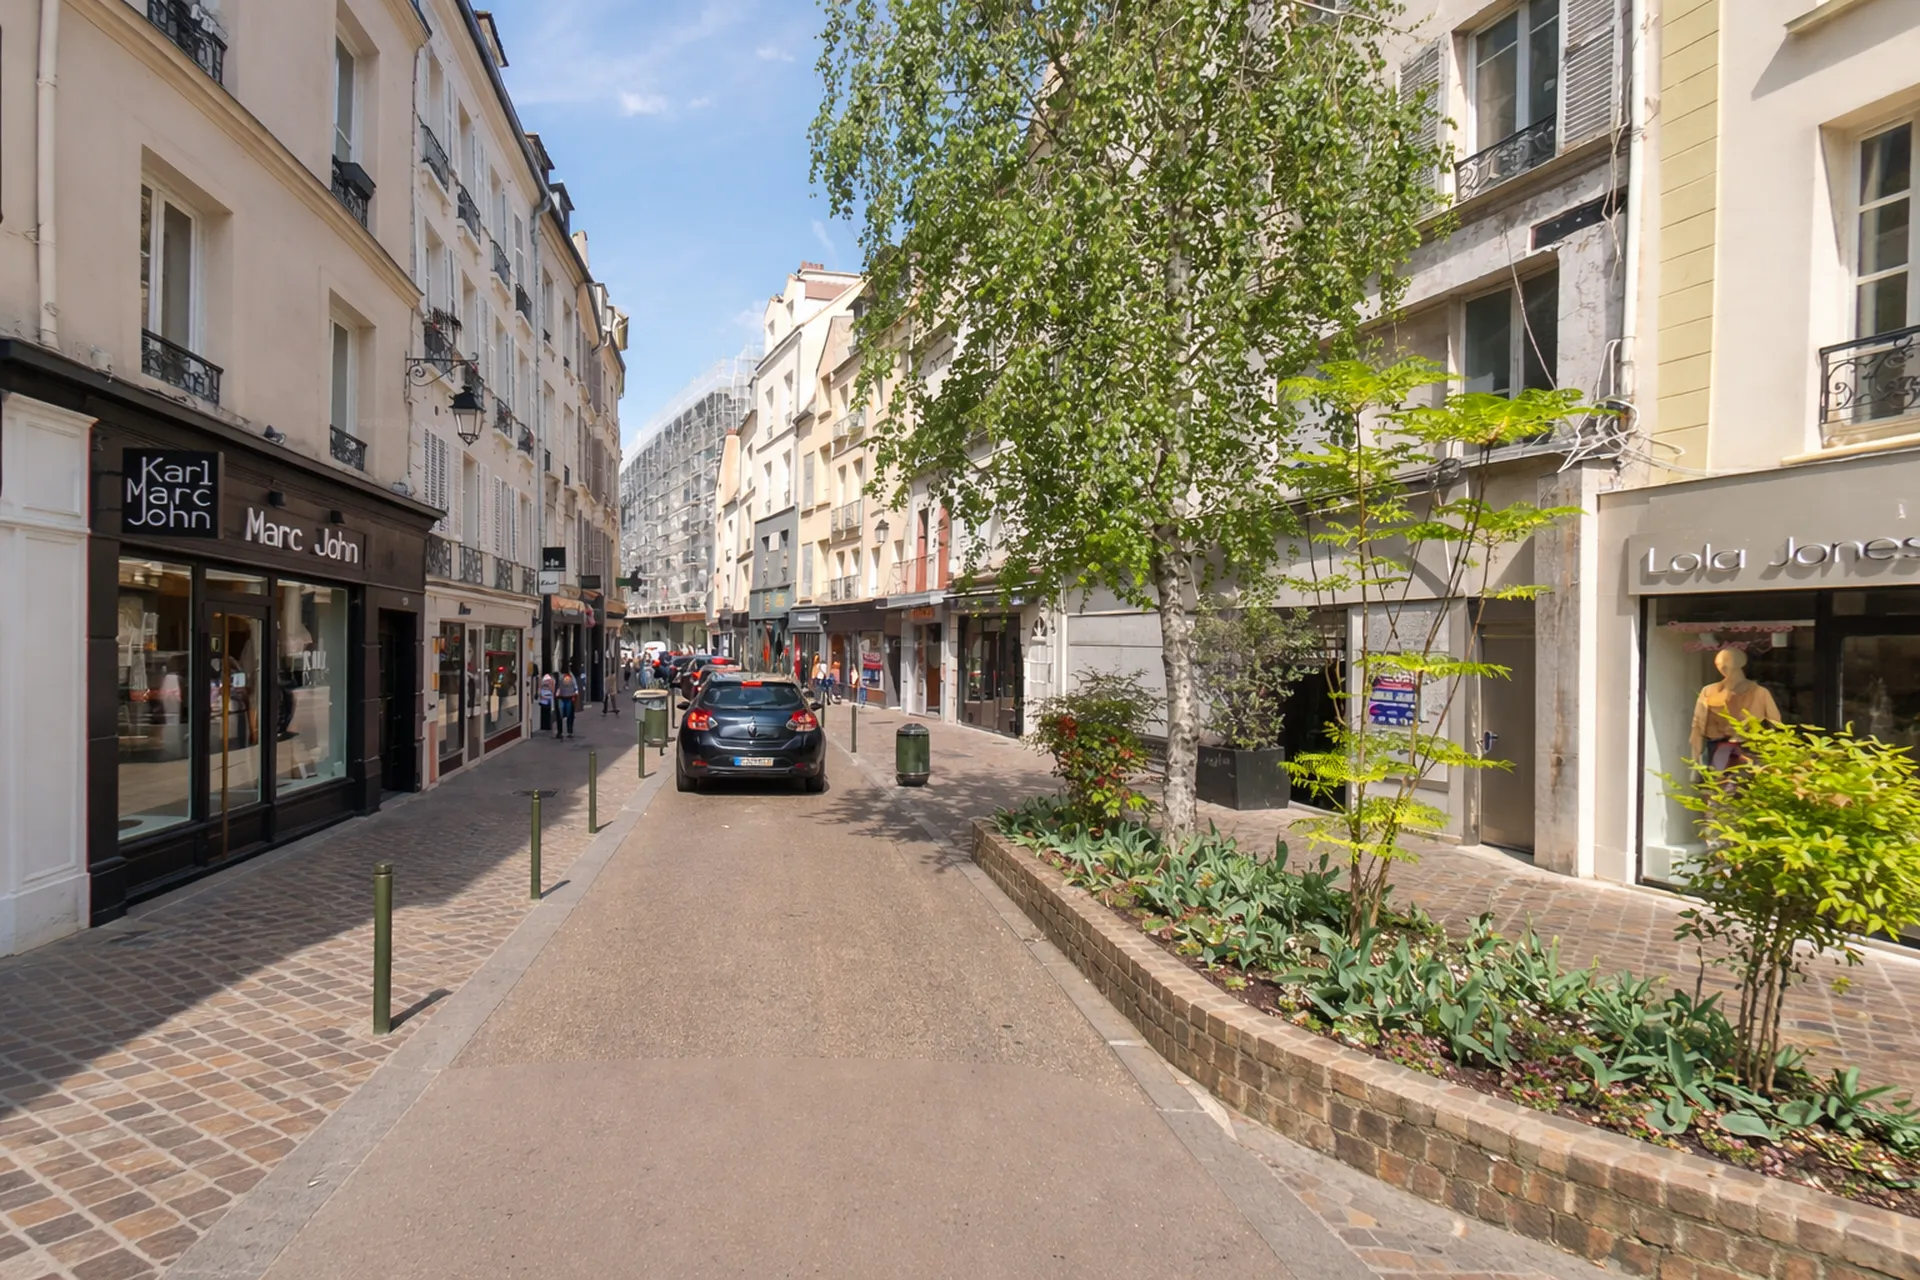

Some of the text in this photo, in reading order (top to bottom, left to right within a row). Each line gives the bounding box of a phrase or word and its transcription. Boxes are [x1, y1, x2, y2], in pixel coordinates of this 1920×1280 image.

[141, 456, 213, 486] Karl
[126, 477, 211, 507] Marc
[127, 499, 211, 529] John
[244, 506, 359, 564] Marc John
[1646, 543, 1747, 574] Lola
